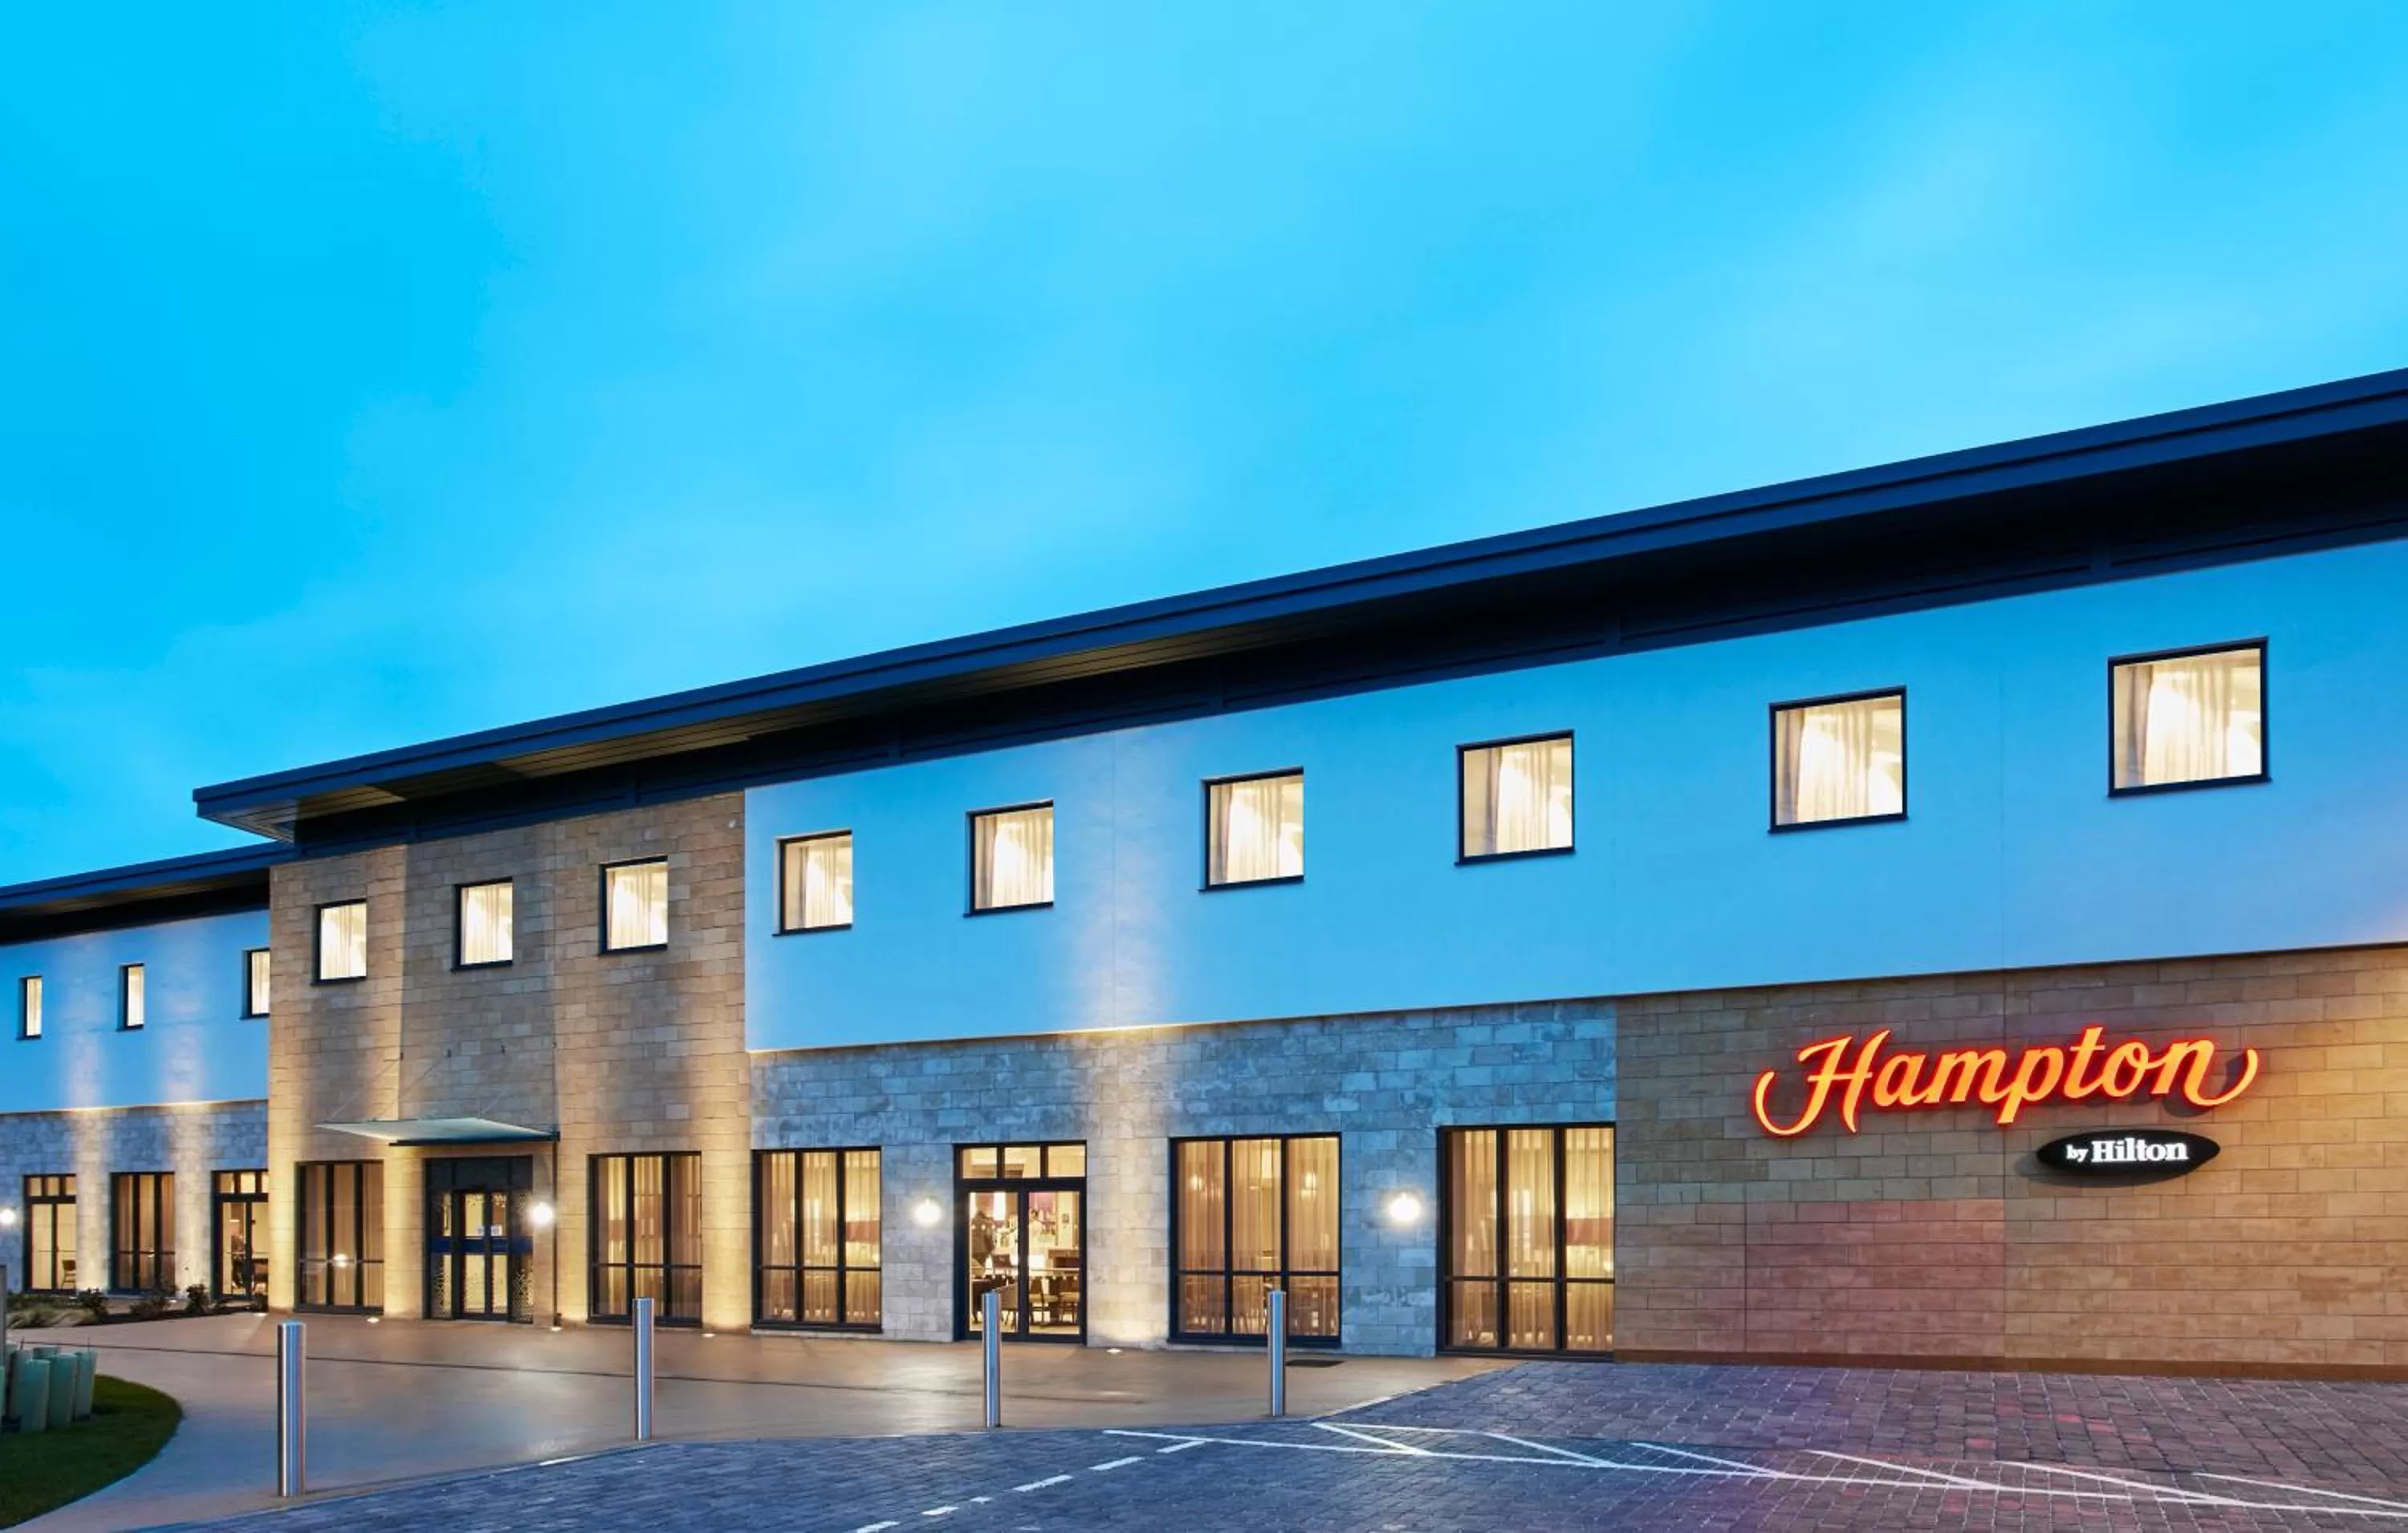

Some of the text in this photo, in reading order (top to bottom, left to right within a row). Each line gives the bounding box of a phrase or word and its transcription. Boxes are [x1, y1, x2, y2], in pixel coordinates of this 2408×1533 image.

[1755, 1027, 2259, 1136] Hampton
[2066, 1137, 2190, 1162] by Hilton
